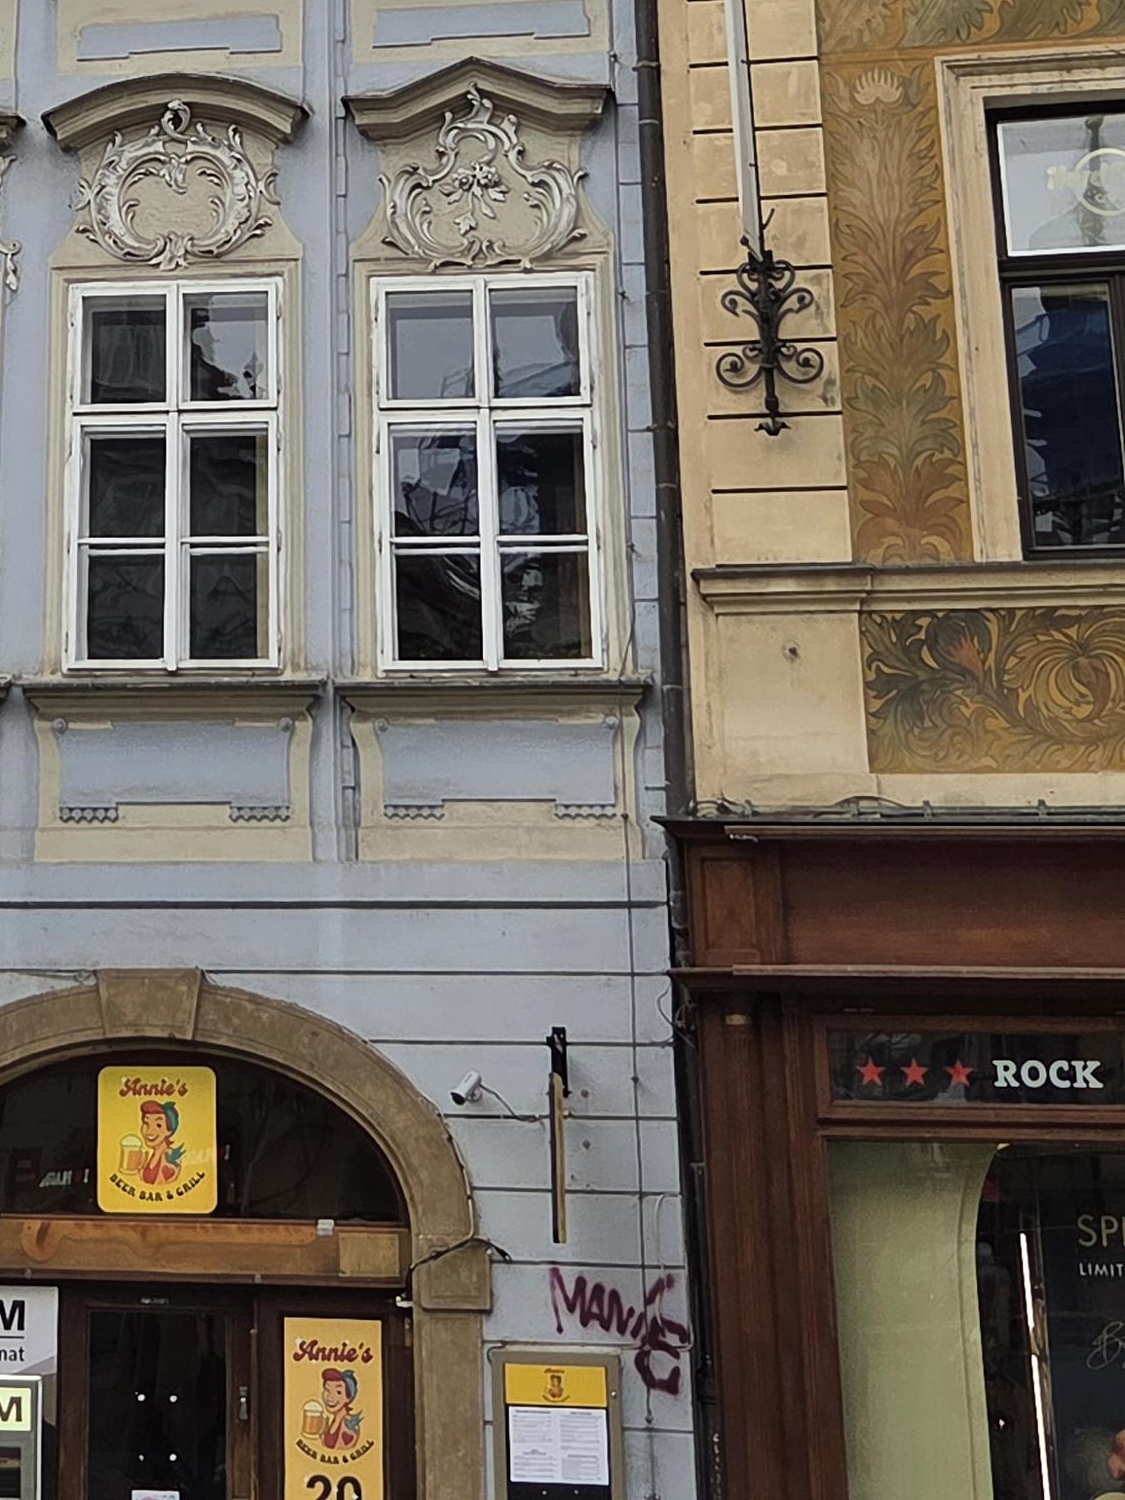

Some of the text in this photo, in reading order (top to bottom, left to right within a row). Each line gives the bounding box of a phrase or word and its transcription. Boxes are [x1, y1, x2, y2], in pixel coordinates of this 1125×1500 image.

[118, 1076, 189, 1098] Annie's
[991, 1059, 1105, 1089] ROCK
[109, 1173, 137, 1197] BEER
[138, 1190, 163, 1202] BAR
[175, 1171, 206, 1197] GRILL
[1077, 1214, 1125, 1248] SP
[1079, 1262, 1124, 1277] LIMIT
[293, 1338, 374, 1364] Annie's
